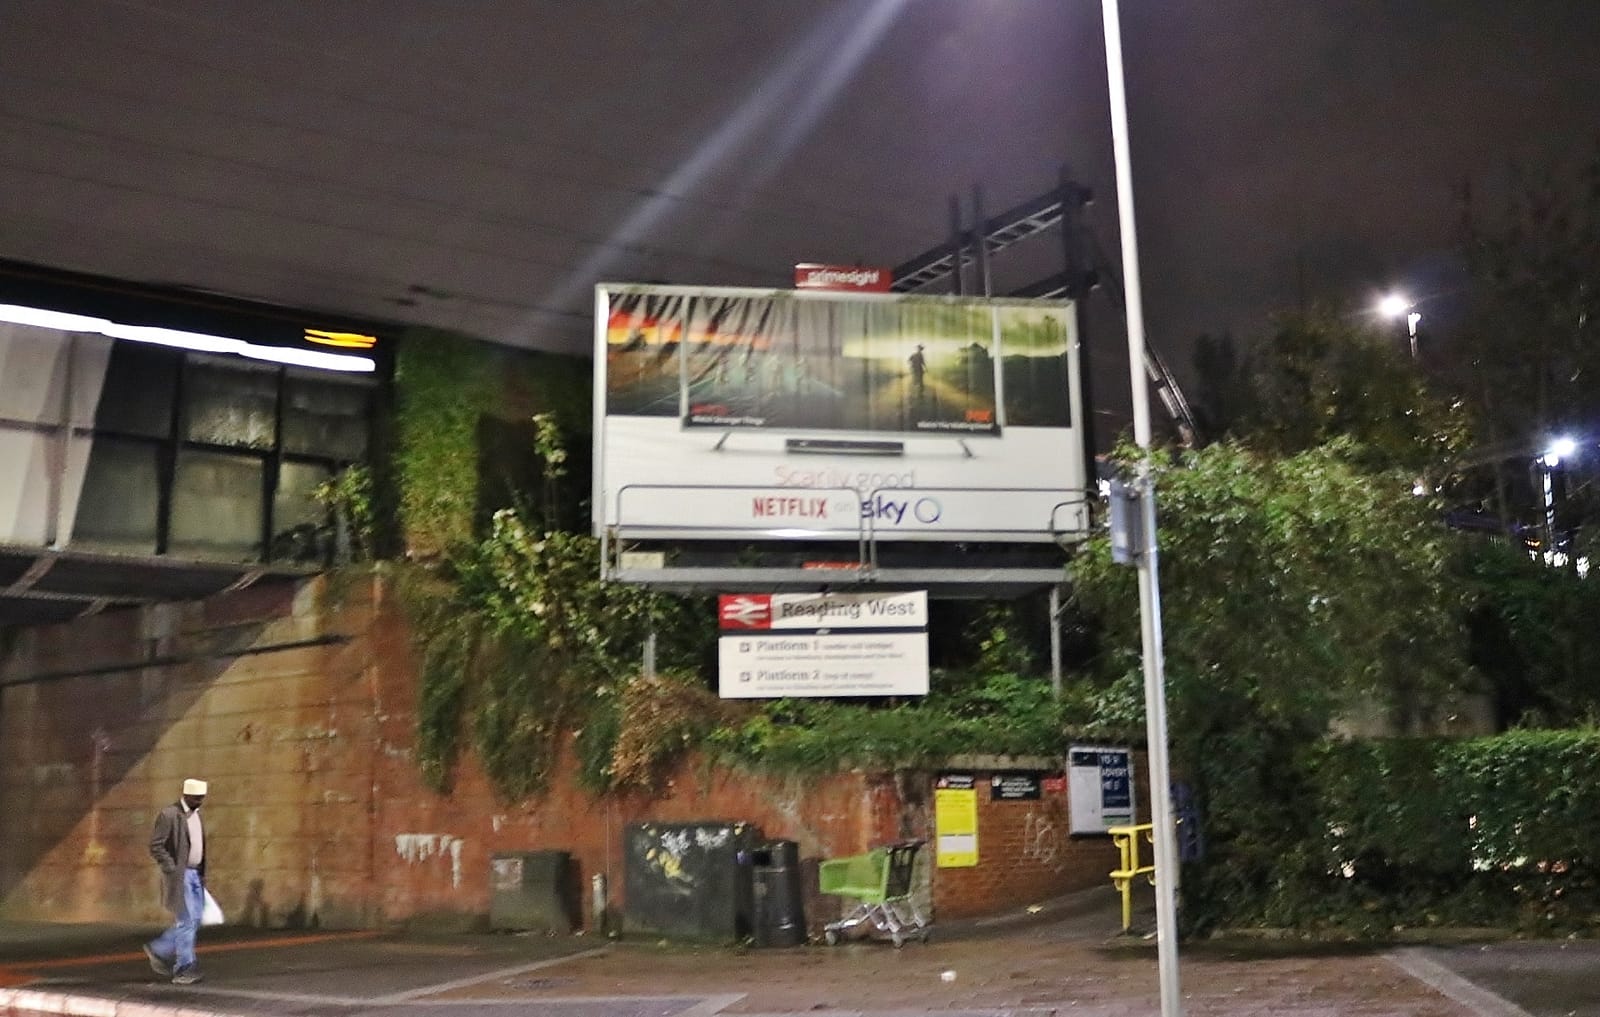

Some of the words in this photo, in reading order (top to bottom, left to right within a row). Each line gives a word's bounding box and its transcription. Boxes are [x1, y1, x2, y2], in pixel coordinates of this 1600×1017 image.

[774, 465, 850, 489] Scarily
[856, 469, 915, 493] good
[752, 498, 828, 519] NETFLIX
[861, 496, 908, 525] sky
[781, 602, 861, 619] Reading
[868, 600, 916, 616] West
[756, 640, 808, 651] Platform
[756, 670, 809, 681] Platform
[812, 670, 820, 681] 2
